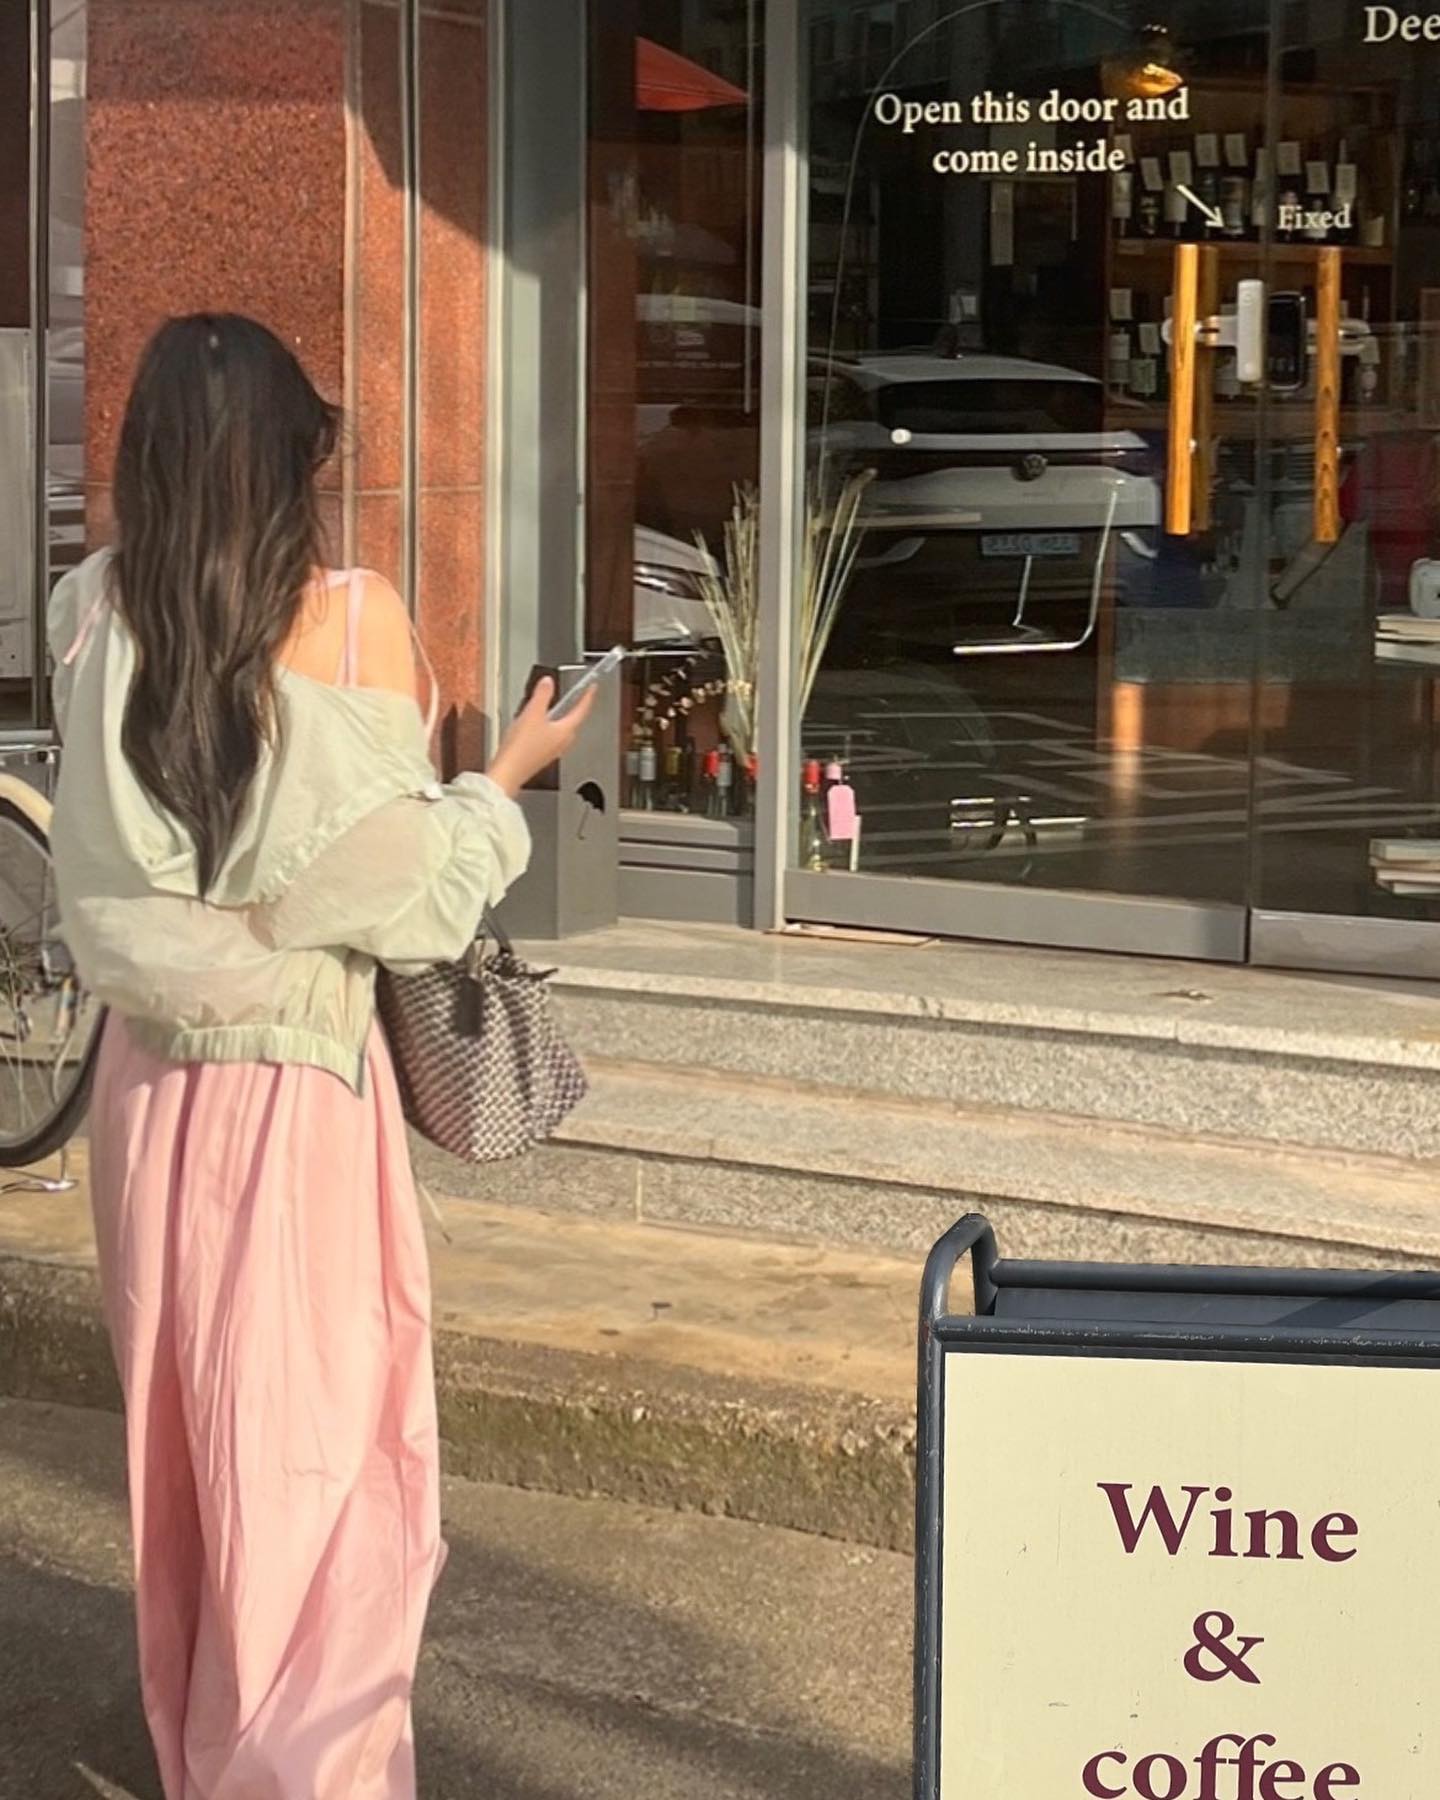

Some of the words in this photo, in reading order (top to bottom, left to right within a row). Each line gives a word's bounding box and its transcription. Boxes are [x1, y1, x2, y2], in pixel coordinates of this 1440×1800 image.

[1363, 5, 1440, 42] Dee
[874, 93, 962, 134] Open
[971, 90, 1031, 123] this
[1038, 89, 1119, 122] door
[1125, 87, 1190, 121] and
[932, 149, 1019, 174] come
[1025, 139, 1126, 173] inside
[1277, 203, 1352, 230] Fixed
[1096, 1482, 1359, 1562] Wine
[1183, 1610, 1265, 1684] &
[1082, 1733, 1361, 1800] coffee
